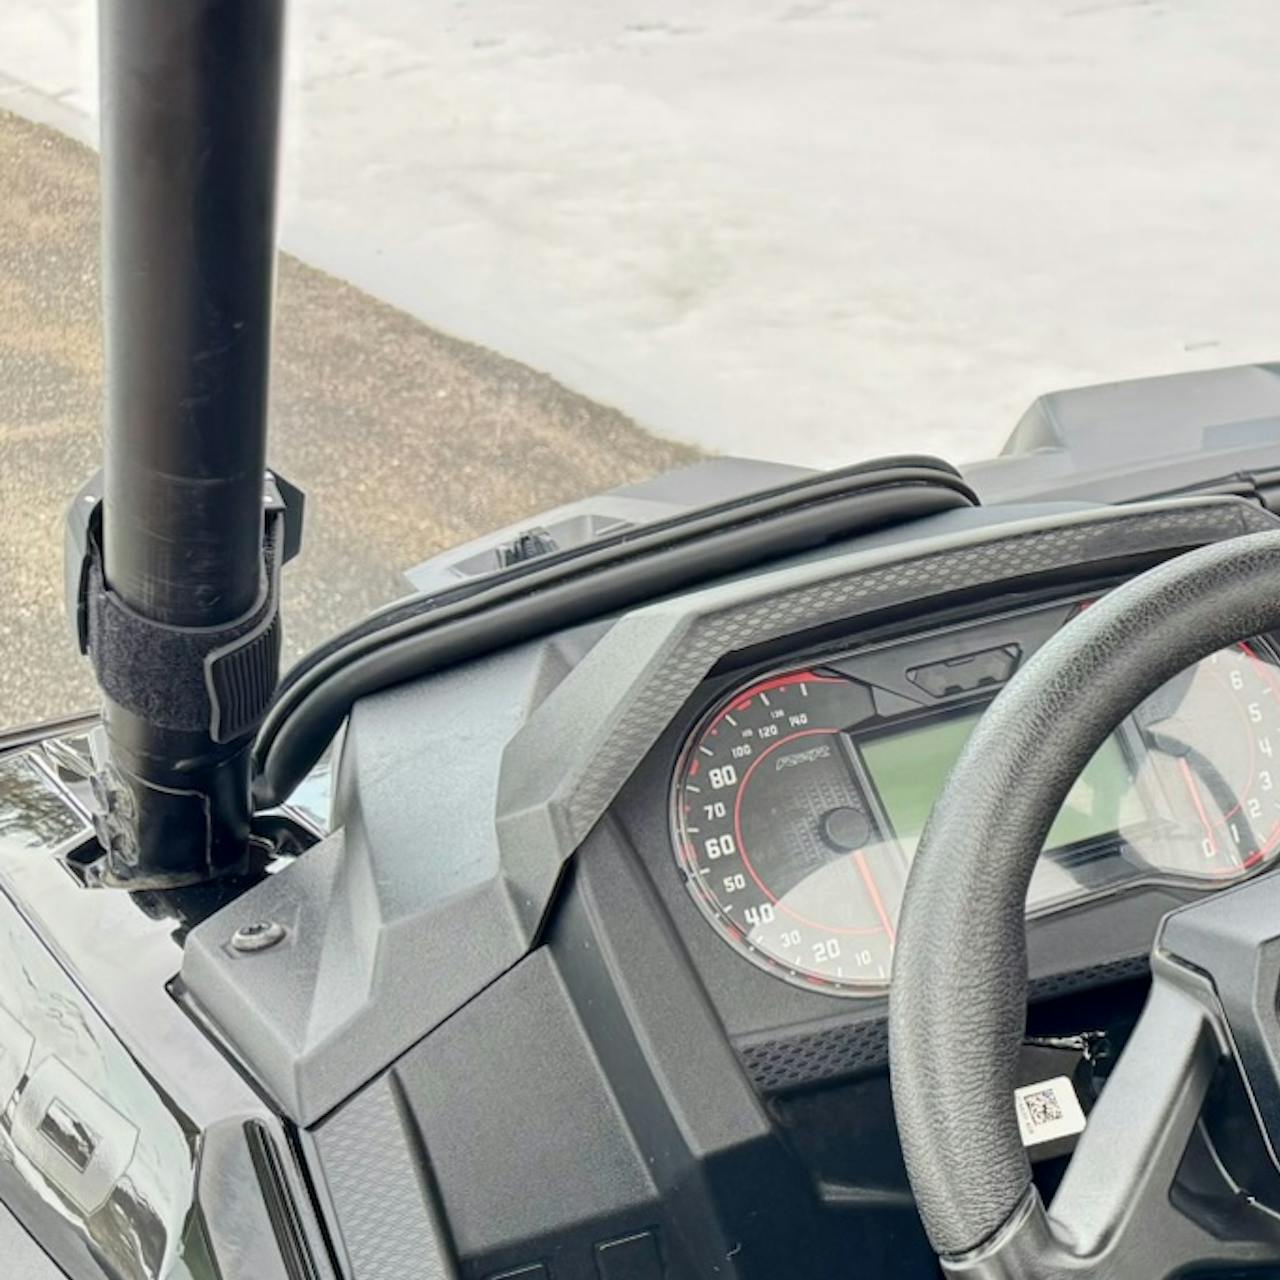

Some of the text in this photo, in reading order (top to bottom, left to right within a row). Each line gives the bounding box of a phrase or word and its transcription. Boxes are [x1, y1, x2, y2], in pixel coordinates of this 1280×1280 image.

[1230, 670, 1244, 690] 6
[789, 713, 808, 727] 140
[1248, 703, 1262, 722] 5
[758, 725, 778, 739] 120
[731, 745, 752, 759] 100
[1258, 737, 1273, 757] 4
[708, 765, 737, 789] 80
[1259, 771, 1272, 790] 3
[704, 802, 726, 820] 70
[1248, 798, 1262, 818] 2
[1231, 824, 1241, 843] 1
[705, 834, 736, 859] 60
[1202, 838, 1216, 857] 0
[723, 874, 745, 892] 50
[744, 903, 775, 927] 40
[780, 930, 801, 947] 30
[812, 938, 841, 962] 20
[854, 950, 871, 966] 10
